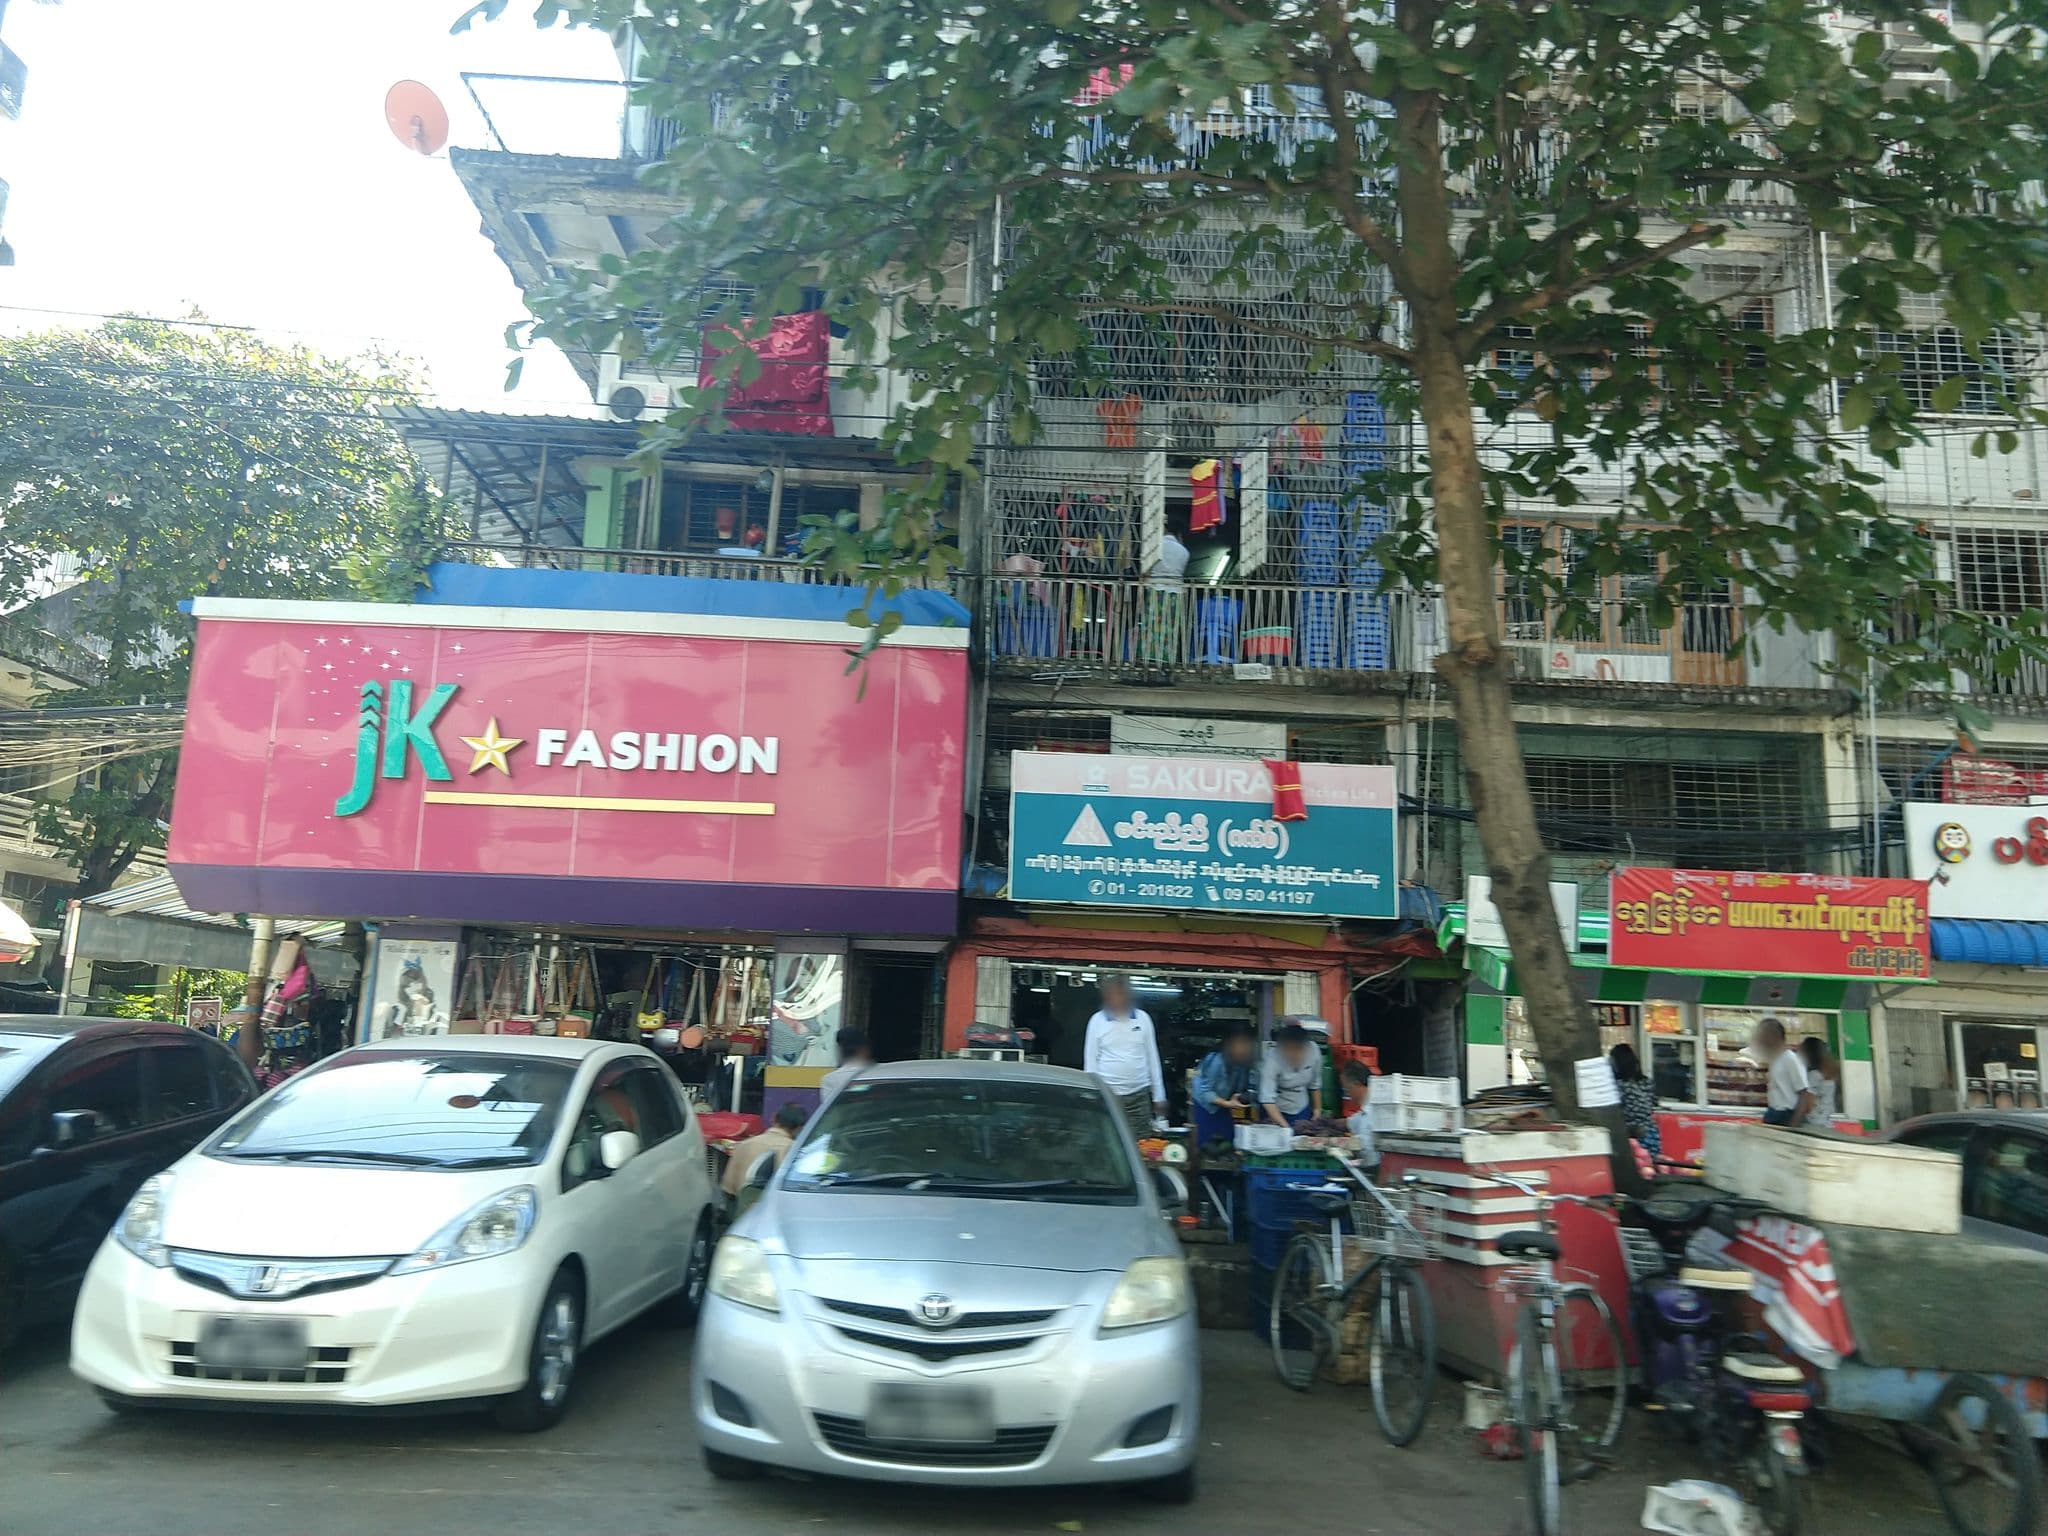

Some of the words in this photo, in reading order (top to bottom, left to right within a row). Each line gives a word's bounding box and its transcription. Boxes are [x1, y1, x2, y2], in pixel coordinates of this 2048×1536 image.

[536, 728, 779, 775] FASHION
[1126, 764, 1274, 796] SAKURA
[1107, 882, 1126, 895] 01
[1137, 883, 1194, 899] 201822
[1223, 887, 1243, 901] 09
[1267, 890, 1315, 905] 41197
